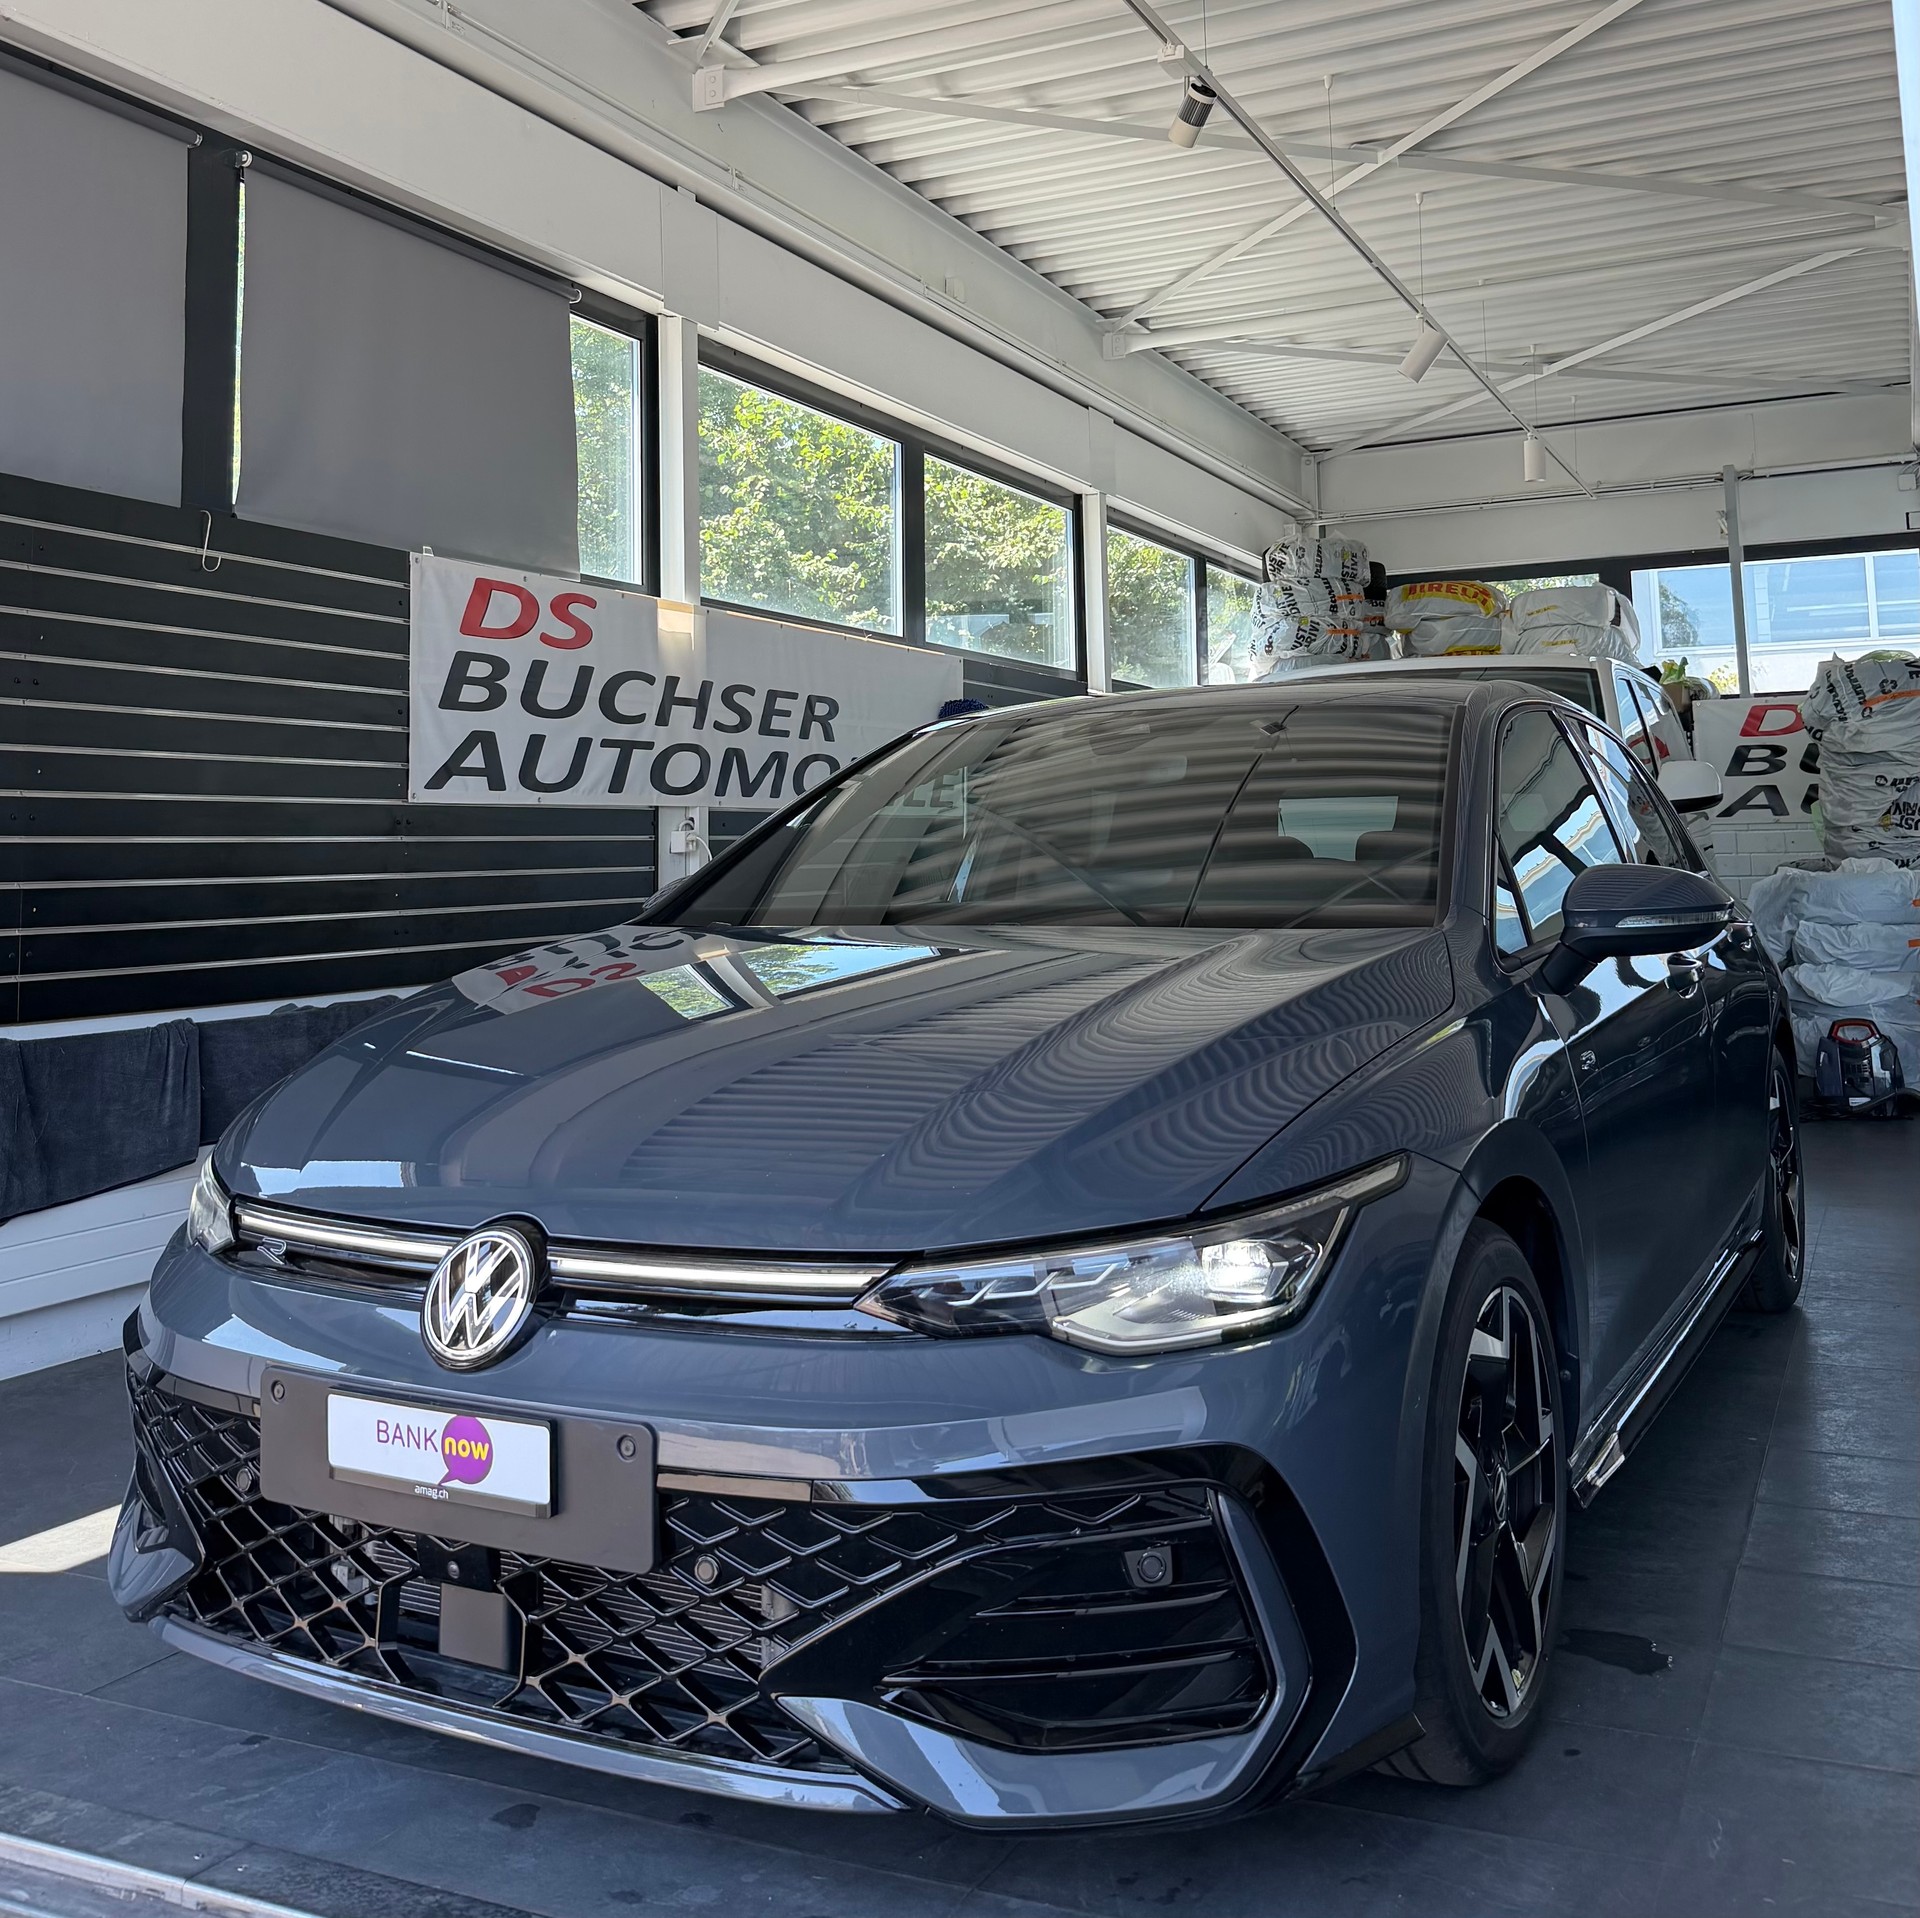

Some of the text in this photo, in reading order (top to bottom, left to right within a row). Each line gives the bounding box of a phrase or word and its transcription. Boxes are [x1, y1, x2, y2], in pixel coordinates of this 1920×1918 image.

[459, 577, 597, 650] DS
[438, 650, 840, 743] BUCHSER
[376, 1419, 490, 1461] BANK now
[414, 1485, 449, 1500] amag.ch
